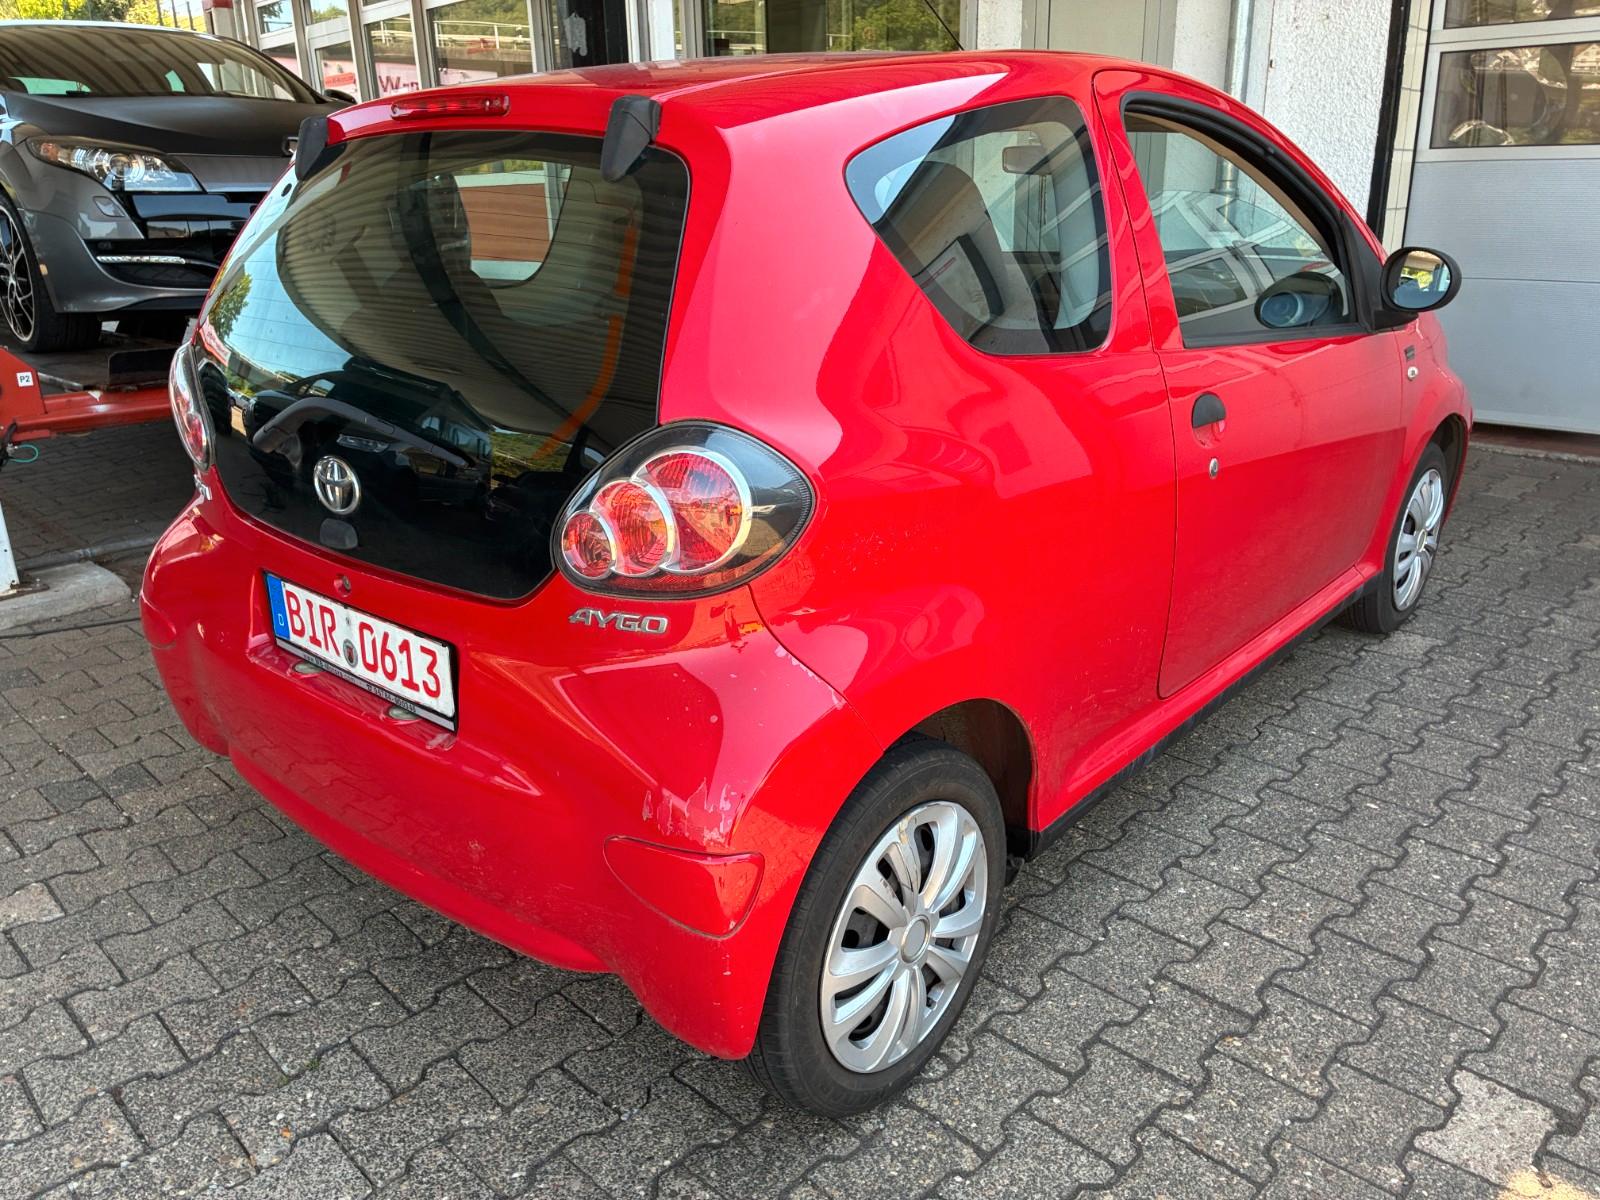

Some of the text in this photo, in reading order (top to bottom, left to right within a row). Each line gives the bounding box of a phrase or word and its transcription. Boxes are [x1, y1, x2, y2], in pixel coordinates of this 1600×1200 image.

[19, 375, 31, 384] P2
[568, 607, 668, 634] AYGO
[285, 589, 341, 657] BIR
[358, 621, 441, 698] 0613
